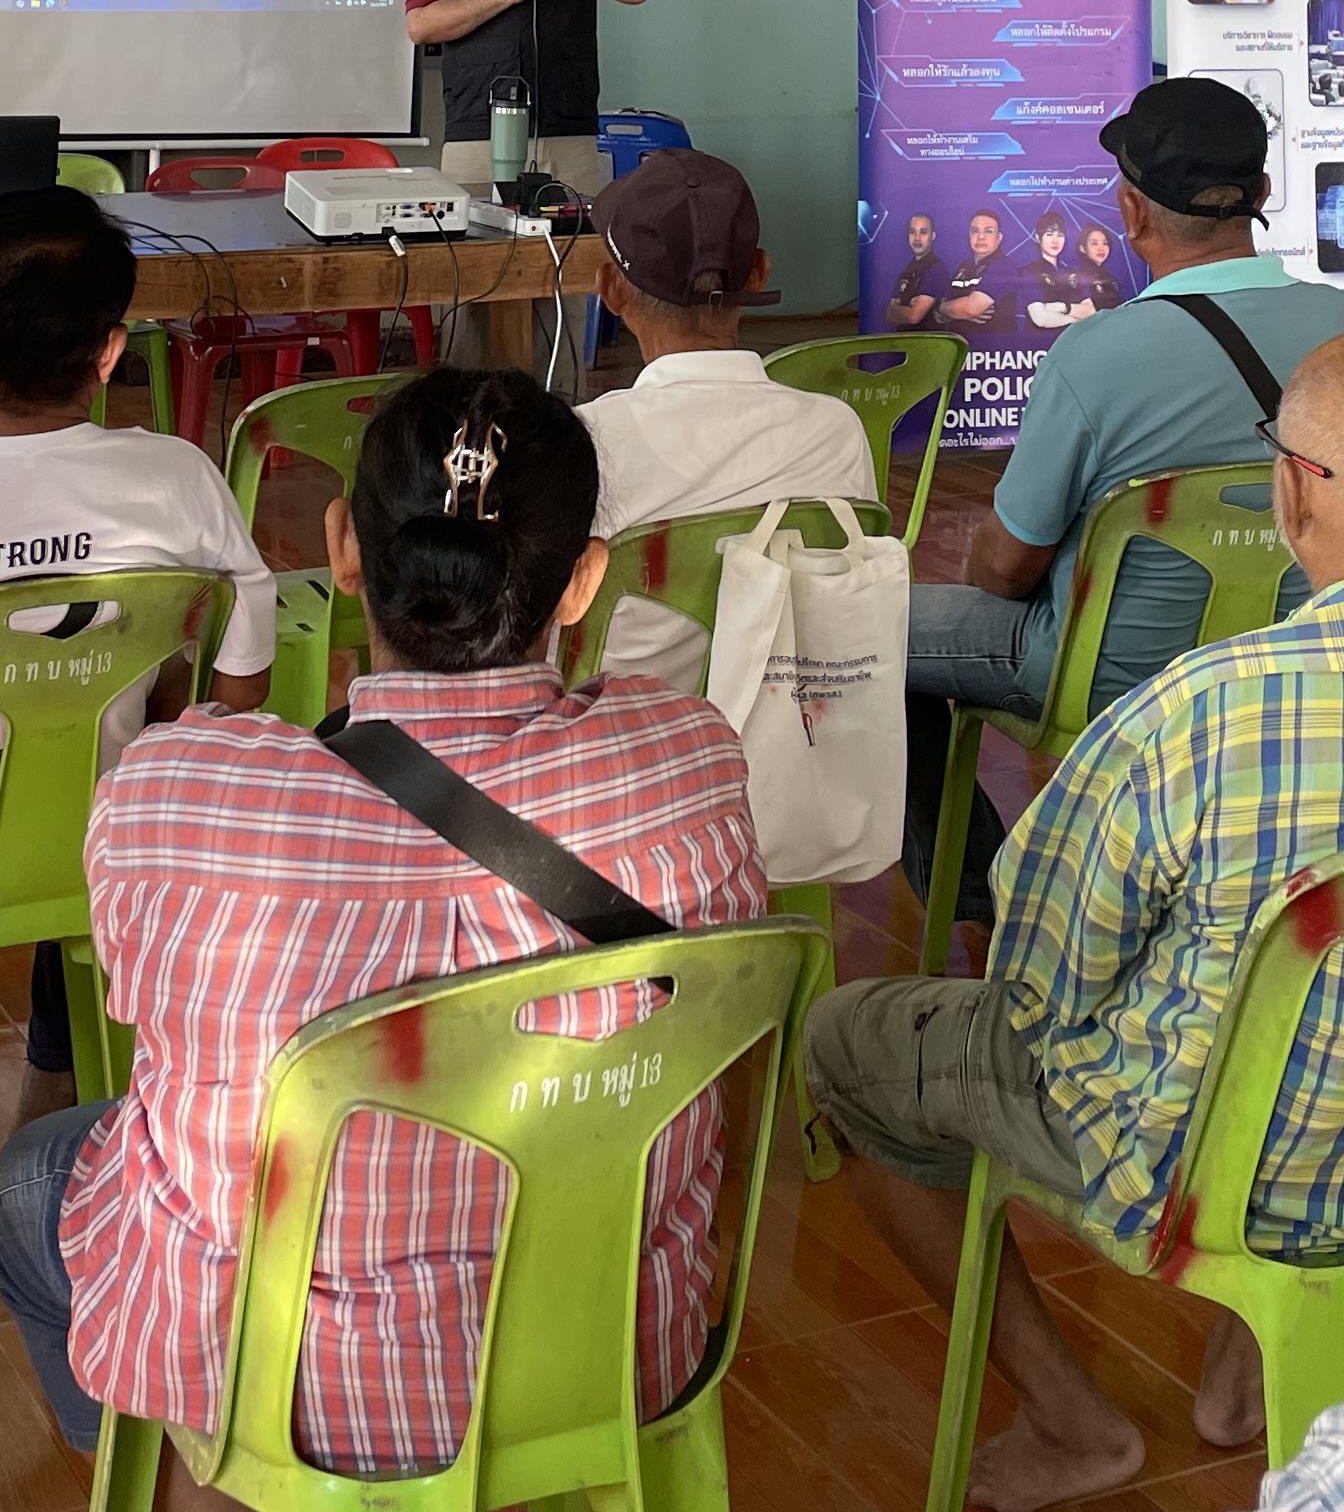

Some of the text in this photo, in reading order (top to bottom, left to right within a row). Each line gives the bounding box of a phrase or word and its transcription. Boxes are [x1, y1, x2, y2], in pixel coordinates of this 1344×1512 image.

[902, 64, 1001, 80] หลอกให้รักแล้วลงทุน
[942, 408, 1019, 428] ONLINE
